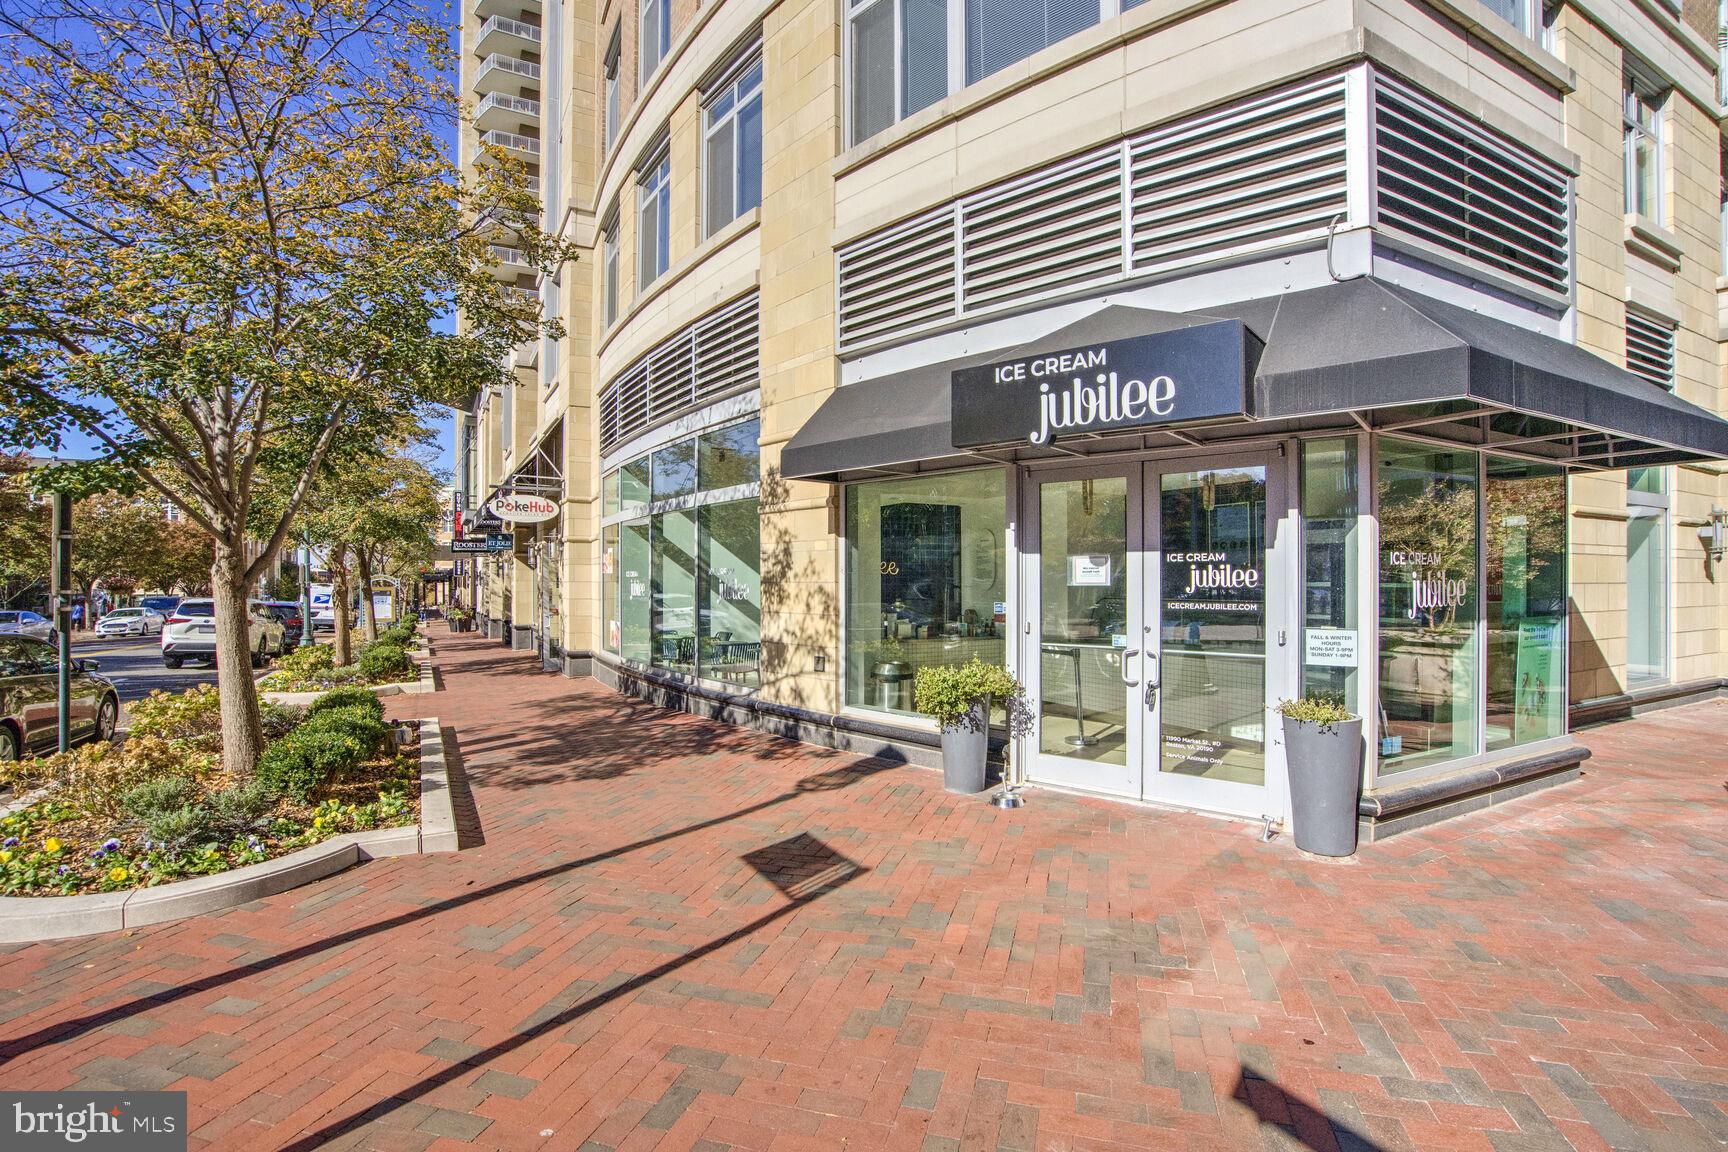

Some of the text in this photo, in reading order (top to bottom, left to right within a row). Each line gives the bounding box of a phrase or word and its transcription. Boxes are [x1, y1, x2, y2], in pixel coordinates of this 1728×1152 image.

[995, 348, 1107, 384] ICE CREAM
[1029, 371, 1176, 445] jubilee
[495, 500, 555, 513] PokeHub
[1166, 552, 1226, 562] ICE CREAM
[1390, 551, 1442, 566] ICE CREAM
[1185, 564, 1258, 594] jubilee
[1408, 571, 1467, 620] jubilee
[1167, 602, 1258, 611] ICECREAMJUBILEE.COM
[1209, 757, 1224, 766] Only
